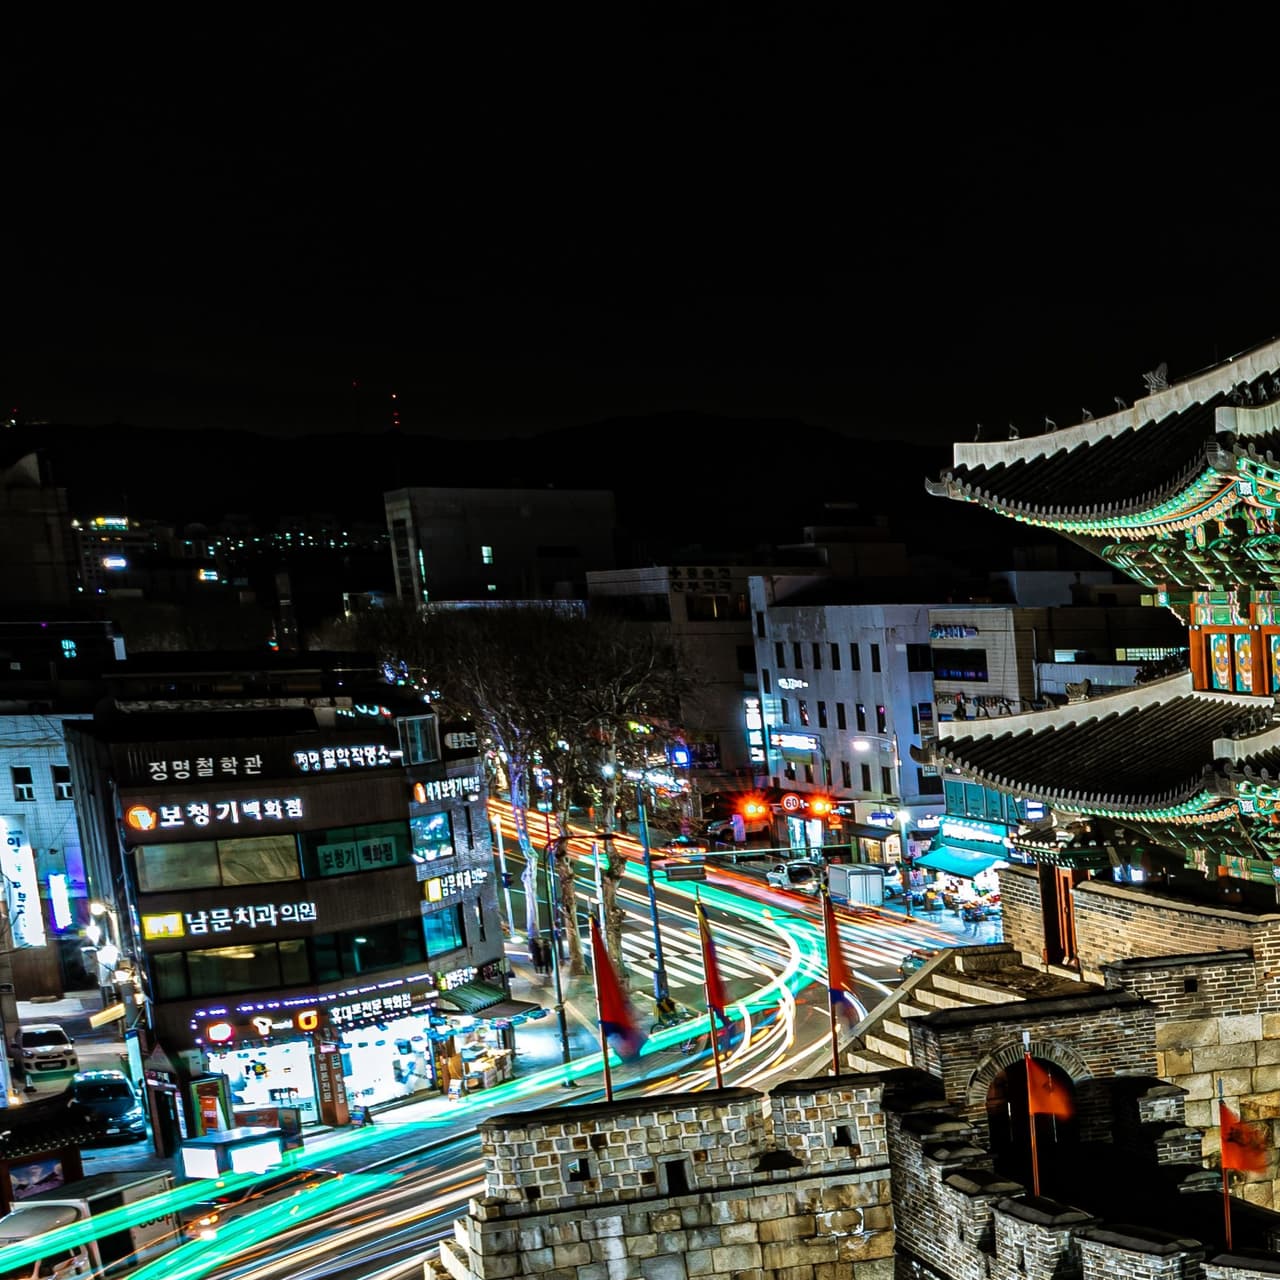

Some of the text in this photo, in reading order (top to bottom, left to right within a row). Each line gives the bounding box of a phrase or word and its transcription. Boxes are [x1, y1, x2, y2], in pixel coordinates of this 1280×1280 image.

[149, 754, 263, 781] 정명철학관
[296, 745, 391, 772] 정명철학작명소
[785, 798, 798, 808] 60
[186, 902, 317, 934] 남문치과의원
